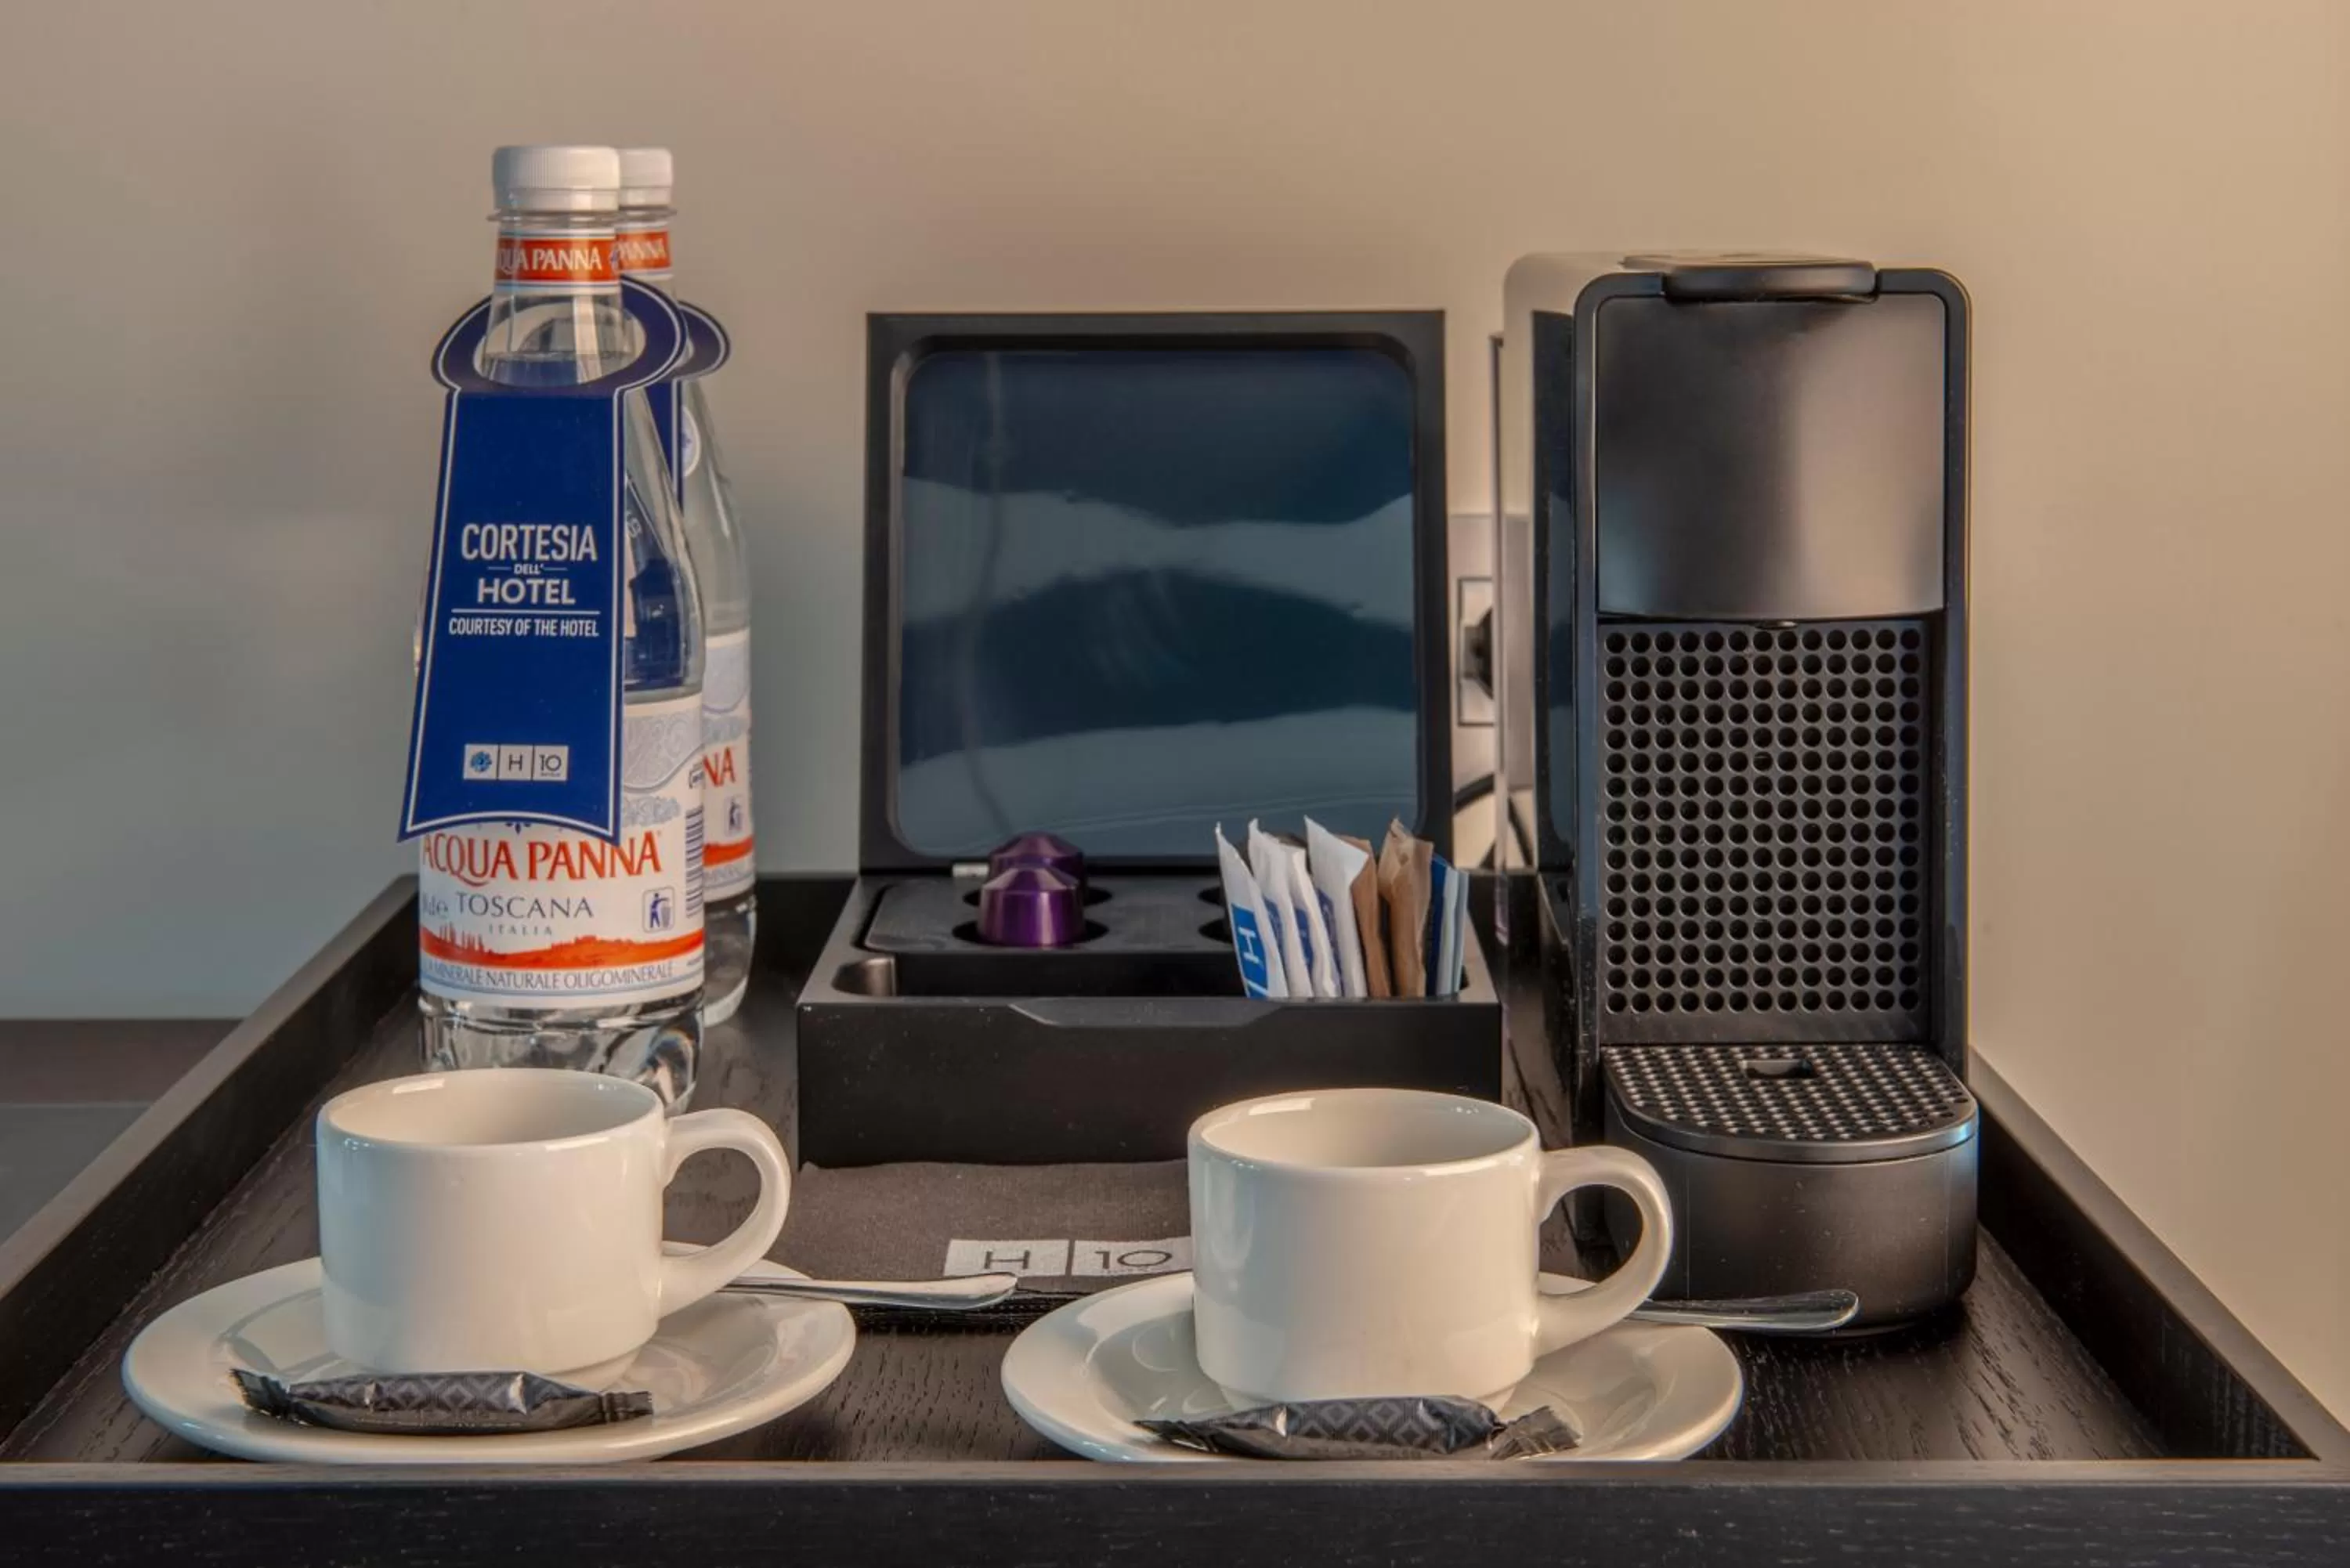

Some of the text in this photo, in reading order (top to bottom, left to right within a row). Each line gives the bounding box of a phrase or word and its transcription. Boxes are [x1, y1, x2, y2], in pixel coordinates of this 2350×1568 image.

[532, 247, 602, 271] PANNA
[461, 523, 598, 562] CORTESIA
[513, 563, 544, 576] DELL'
[476, 578, 576, 605] HOTEL
[449, 617, 600, 638] COURTESY OF THE HOTEL
[508, 754, 562, 771] H 10
[423, 830, 661, 887] ACQUA PANNA
[456, 891, 595, 918] TOSCANA
[488, 923, 553, 936] ITALIA
[483, 970, 561, 990] NATURALE
[563, 961, 674, 989] OLIGOMINERALE
[984, 1250, 1173, 1270] H 10
